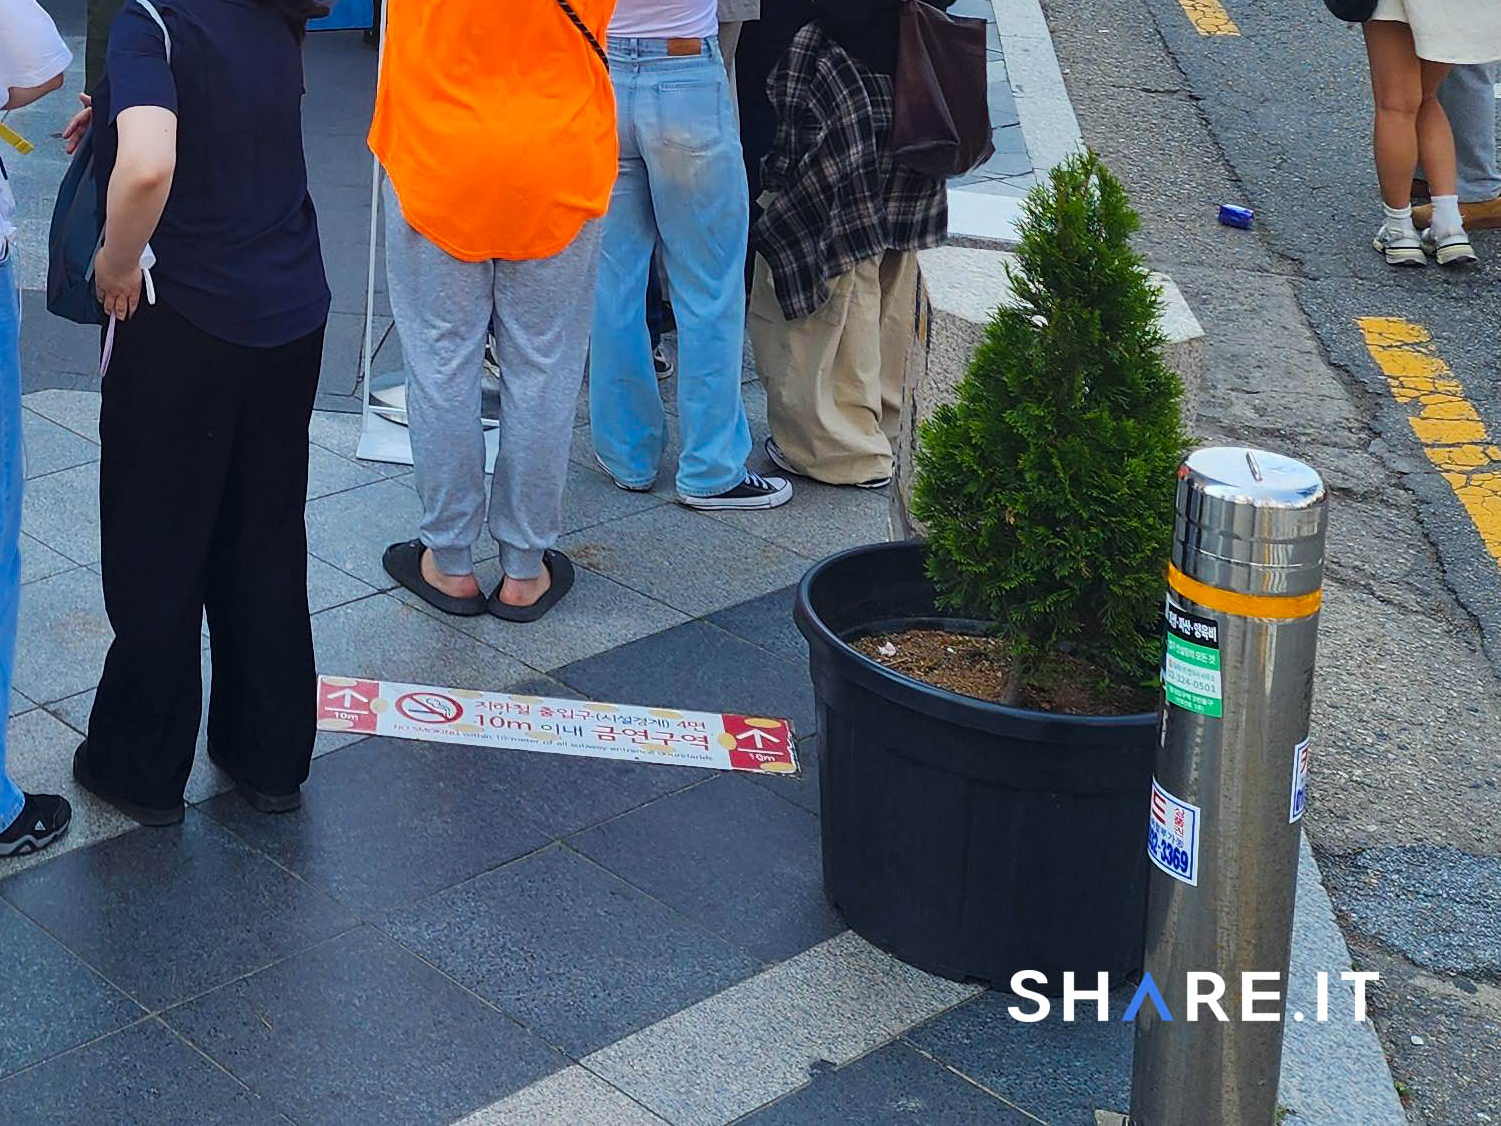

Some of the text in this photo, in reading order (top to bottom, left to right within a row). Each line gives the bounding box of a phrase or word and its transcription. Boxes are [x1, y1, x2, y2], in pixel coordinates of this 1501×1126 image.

[475, 699, 531, 716] 지하철
[333, 711, 360, 722] 10m
[475, 713, 710, 751] 10m 이내 금연구역
[748, 751, 777, 764] 10m
